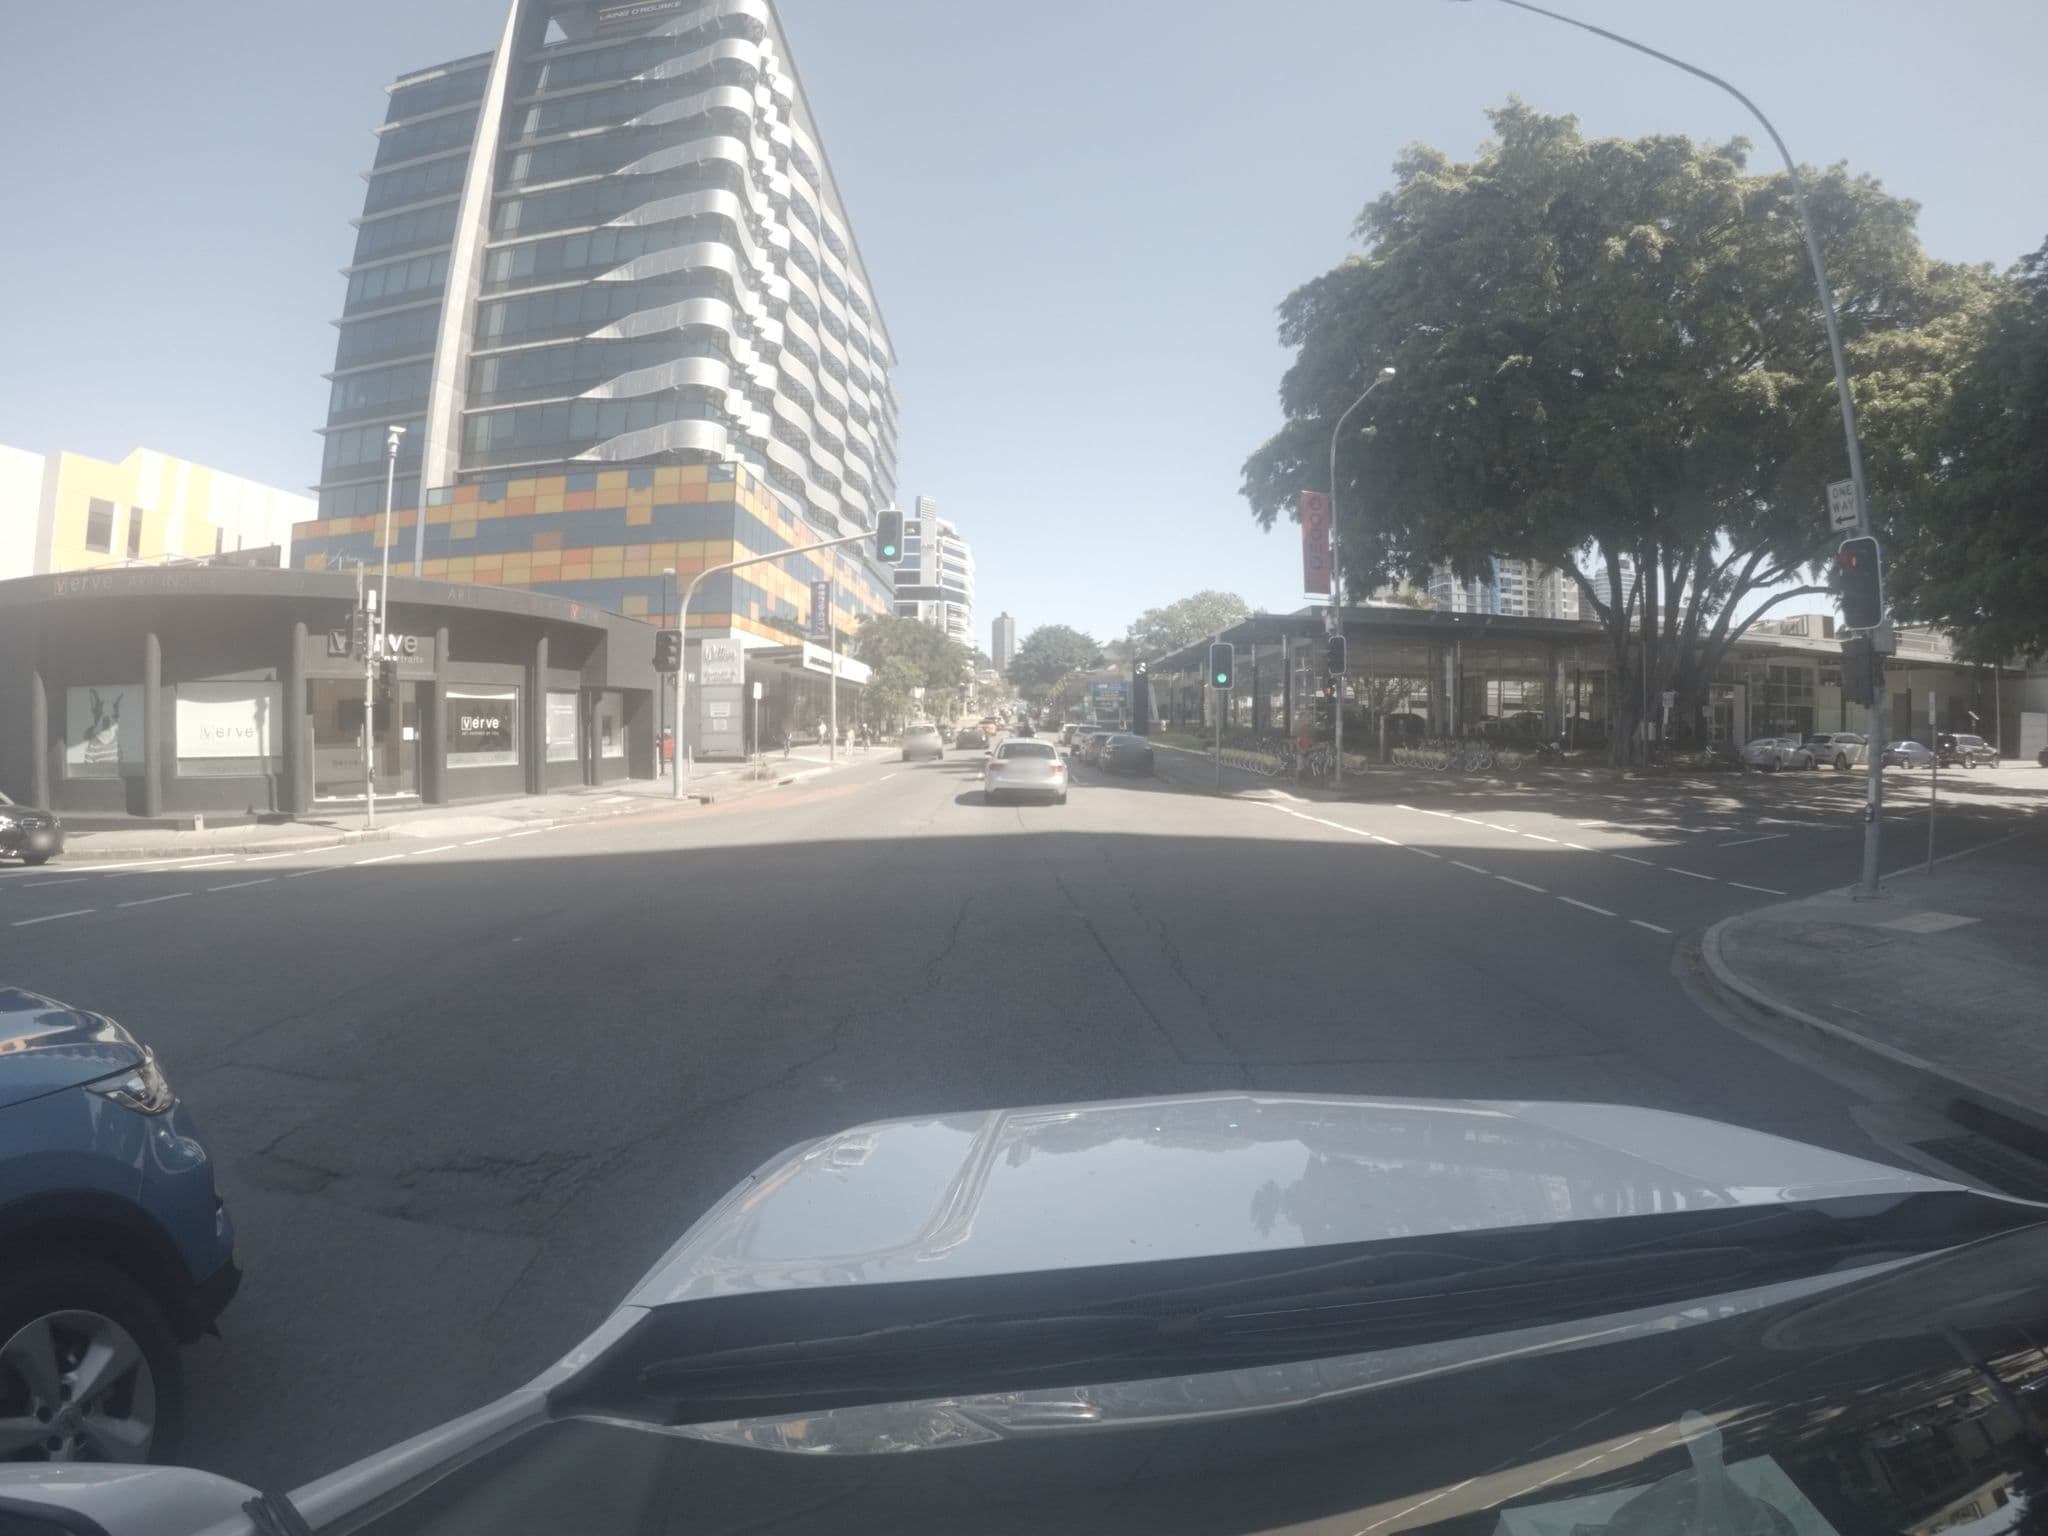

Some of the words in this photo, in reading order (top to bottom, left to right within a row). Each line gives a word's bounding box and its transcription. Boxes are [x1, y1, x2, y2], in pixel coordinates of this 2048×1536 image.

[1832, 485, 1853, 499] ONE
[1832, 498, 1854, 513] WAY
[328, 630, 418, 656] vrve
[461, 715, 499, 730] verve
[200, 726, 254, 740] verve
